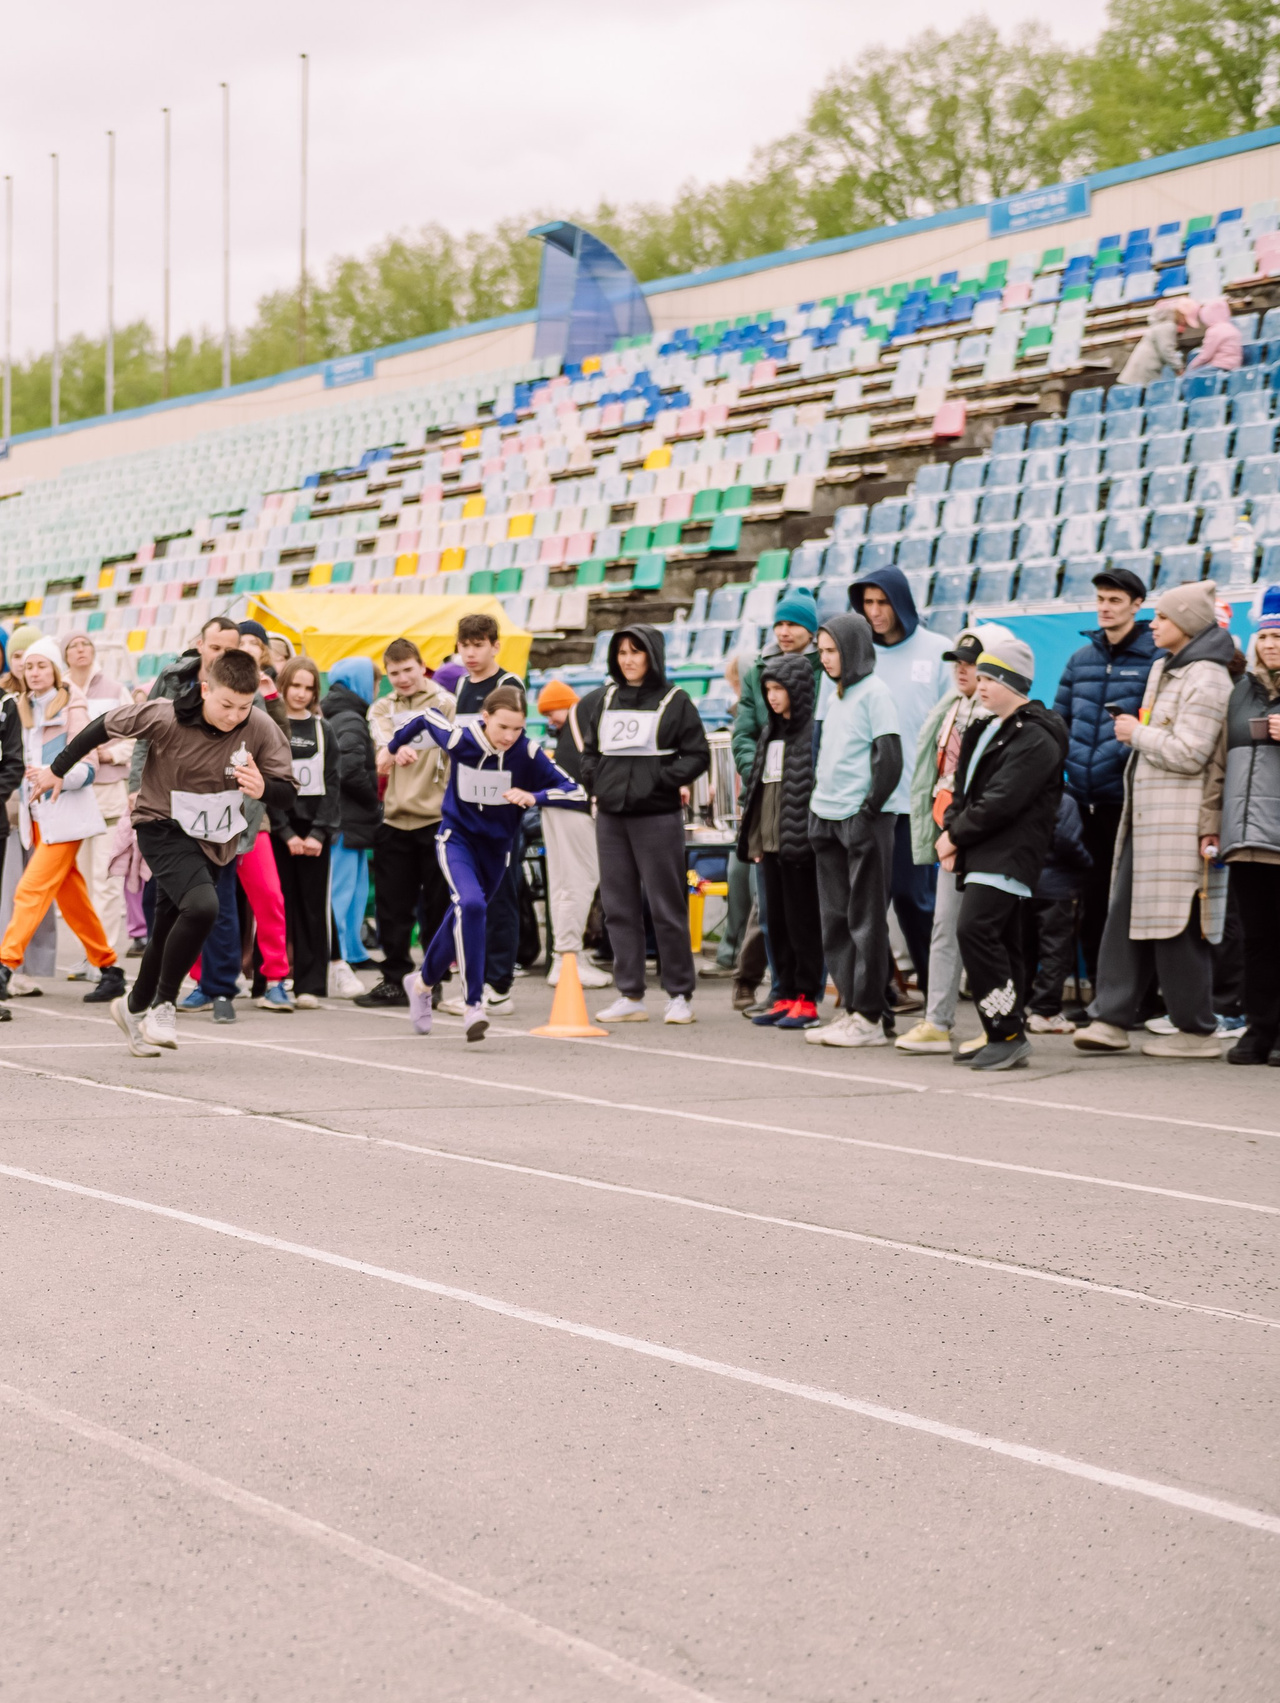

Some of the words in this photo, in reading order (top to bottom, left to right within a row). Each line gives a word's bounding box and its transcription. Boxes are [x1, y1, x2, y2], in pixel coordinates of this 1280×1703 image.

[611, 719, 640, 742] 29
[473, 785, 498, 798] 117
[190, 805, 233, 839] 44
